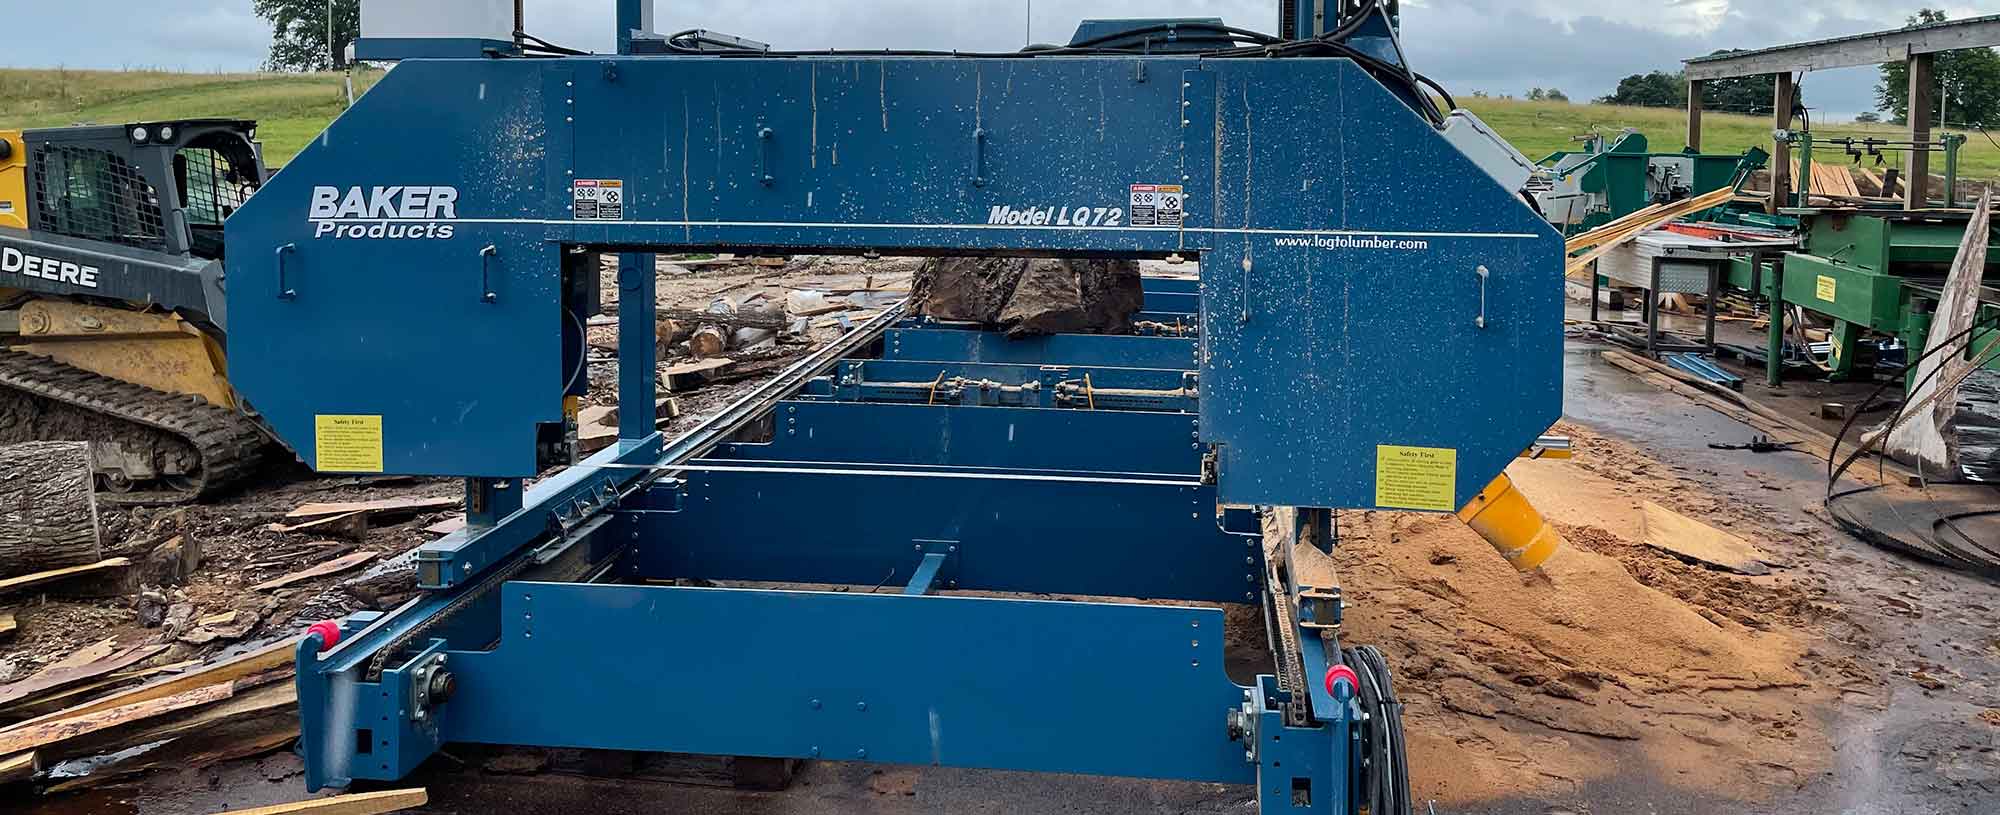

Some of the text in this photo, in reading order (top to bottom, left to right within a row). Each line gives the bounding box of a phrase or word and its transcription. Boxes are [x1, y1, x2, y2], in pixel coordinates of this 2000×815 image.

[309, 186, 458, 218] BAKER
[988, 205, 1055, 225] Model
[314, 220, 454, 239] Products
[1274, 234, 1428, 250] www.logtolumber.com
[1, 246, 99, 288] DEERE
